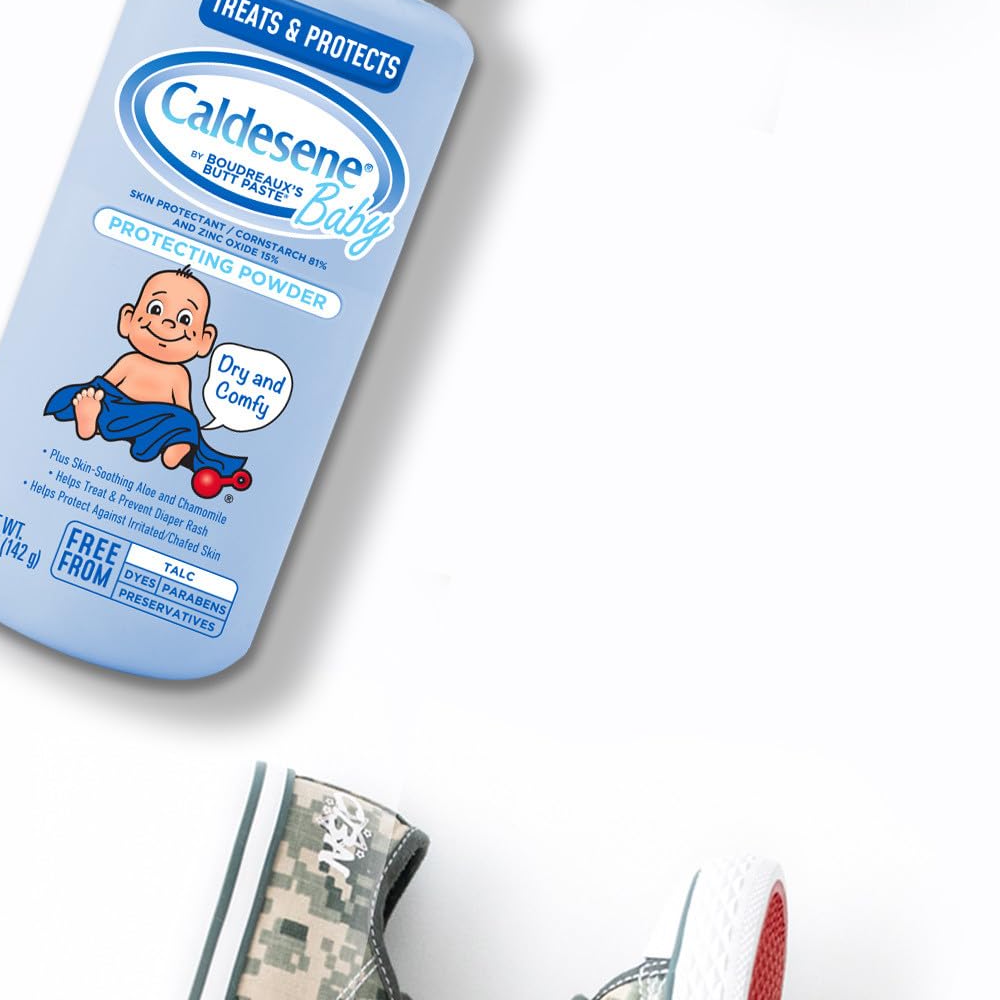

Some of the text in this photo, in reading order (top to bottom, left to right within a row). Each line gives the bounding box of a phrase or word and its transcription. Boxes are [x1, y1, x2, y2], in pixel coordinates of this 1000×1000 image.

[285, 18, 301, 43] &
[304, 24, 400, 80] PROTECTS
[190, 150, 203, 160] BY
[202, 165, 237, 185] BUTT
[129, 189, 154, 206] SKIN
[156, 199, 226, 232] PROTECTANT
[236, 229, 307, 262] CORNSTARCH
[308, 257, 328, 271] 81%
[294, 182, 391, 257] Baby
[172, 218, 279, 265] AND ZINC OXIDE 15%
[108, 216, 327, 310] PROTECTING POWDER
[217, 354, 287, 394] Dry and
[216, 381, 270, 420] Comfy
[49, 448, 227, 525] Plus Skin-Soothing Aloe and Chamomile
[55, 470, 209, 538] Helps Treat & Prevent Diaper Rash
[2, 516, 26, 540] WT.
[29, 480, 221, 562] Helps Protect Against Irritated/Chafed Skin
[0, 537, 29, 562] (142
[26, 549, 41, 569] g)
[65, 527, 122, 566] FREE
[57, 550, 113, 588] FROM
[124, 569, 156, 589] DYES
[164, 561, 196, 582] TALC
[118, 588, 216, 632] PRESERVATIVES
[161, 583, 227, 615] PARABENS
